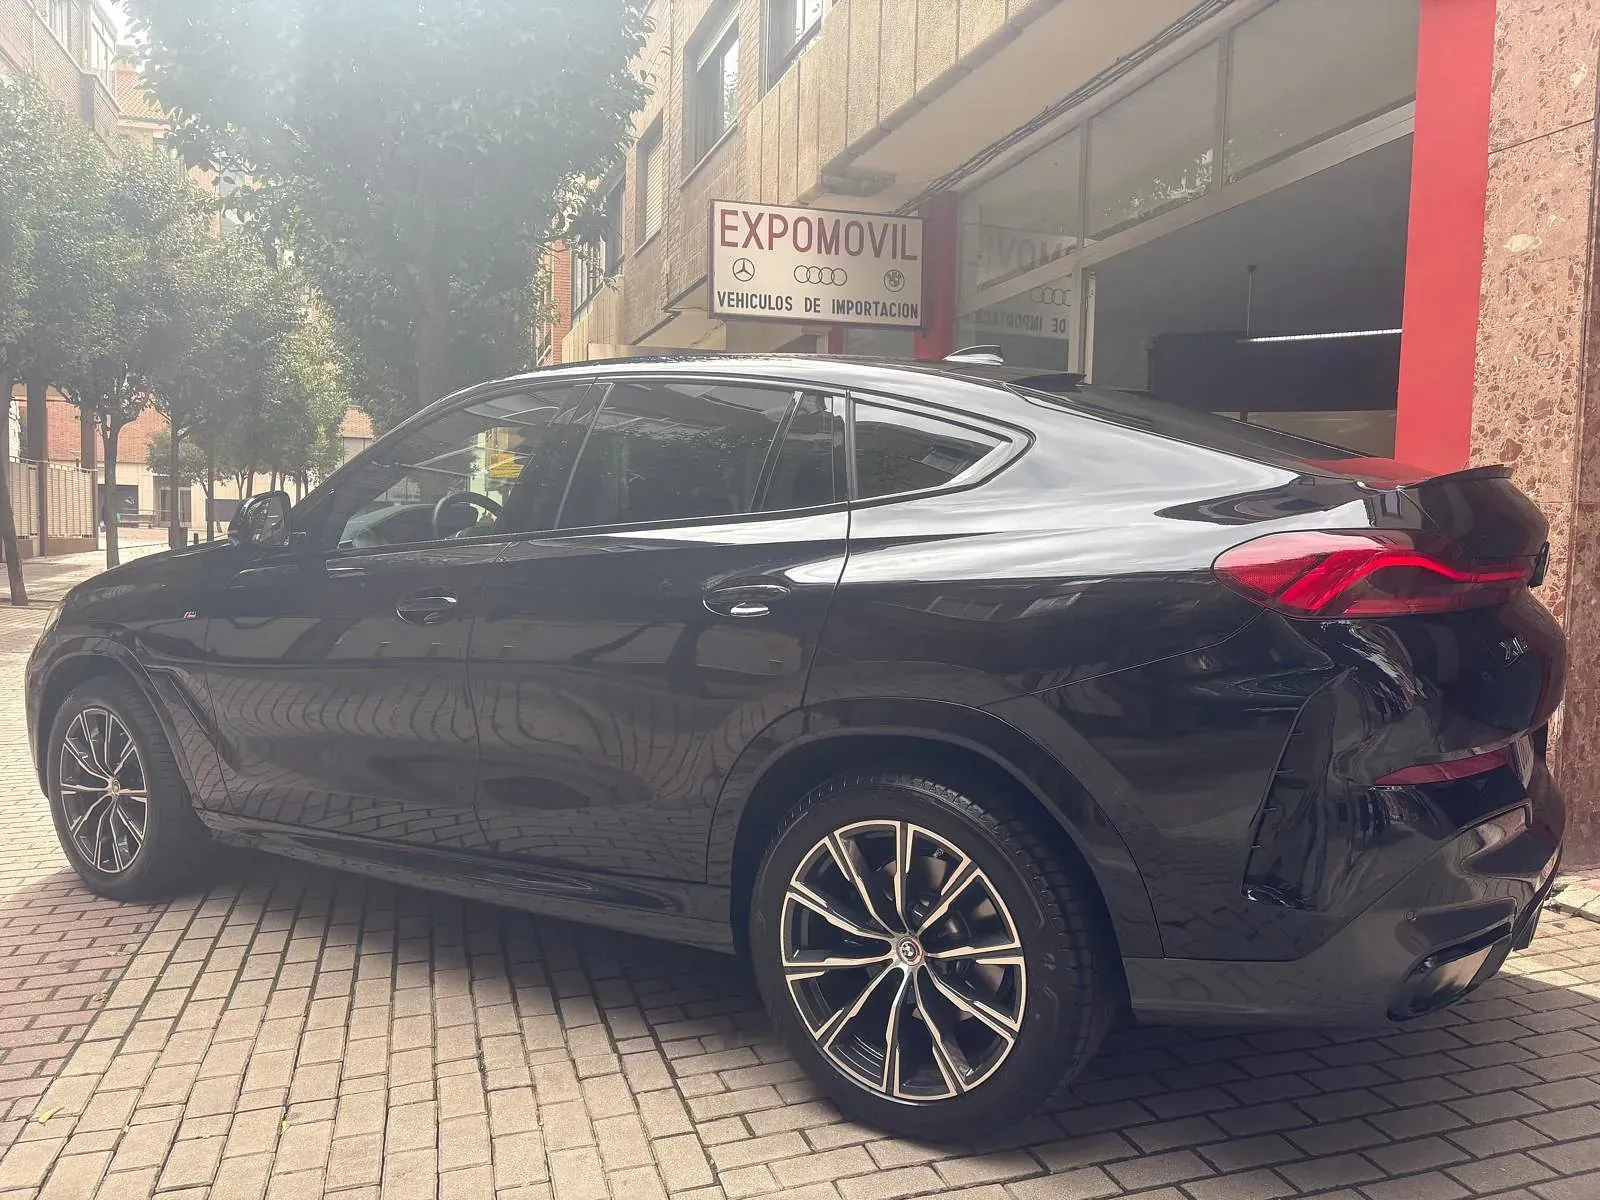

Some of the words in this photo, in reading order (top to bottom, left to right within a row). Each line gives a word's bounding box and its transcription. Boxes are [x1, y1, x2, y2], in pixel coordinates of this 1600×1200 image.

[720, 208, 918, 261] EXPOMOVIL
[717, 290, 793, 312] VEHICULOS
[804, 296, 821, 313] DE
[832, 298, 918, 319] IMPORTACION
